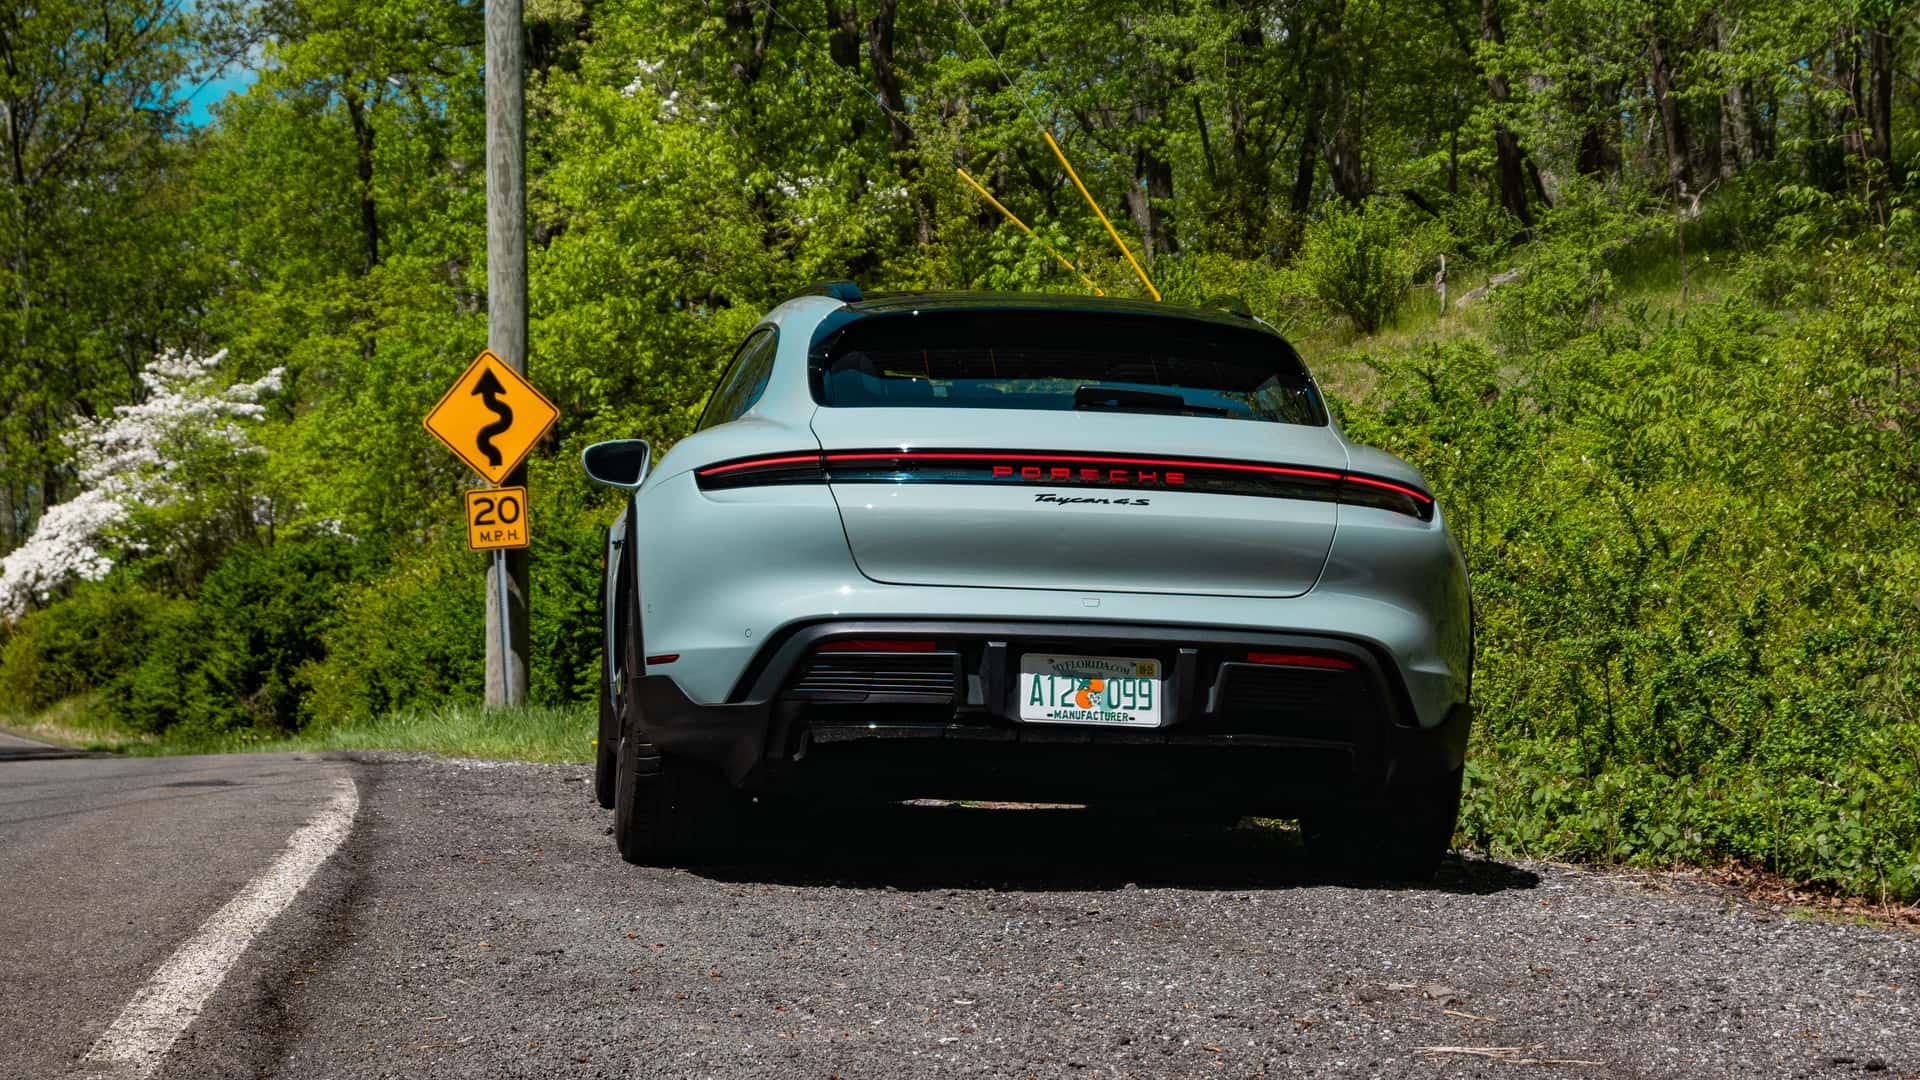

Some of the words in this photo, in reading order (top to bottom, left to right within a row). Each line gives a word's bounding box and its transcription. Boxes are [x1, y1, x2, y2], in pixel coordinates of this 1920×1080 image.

[992, 465, 1185, 484] PORSCHE
[473, 496, 520, 526] 20
[1034, 493, 1111, 506] Taycan
[1113, 498, 1151, 506] 4S
[1030, 673, 1075, 708] A12
[1107, 677, 1153, 711] 099
